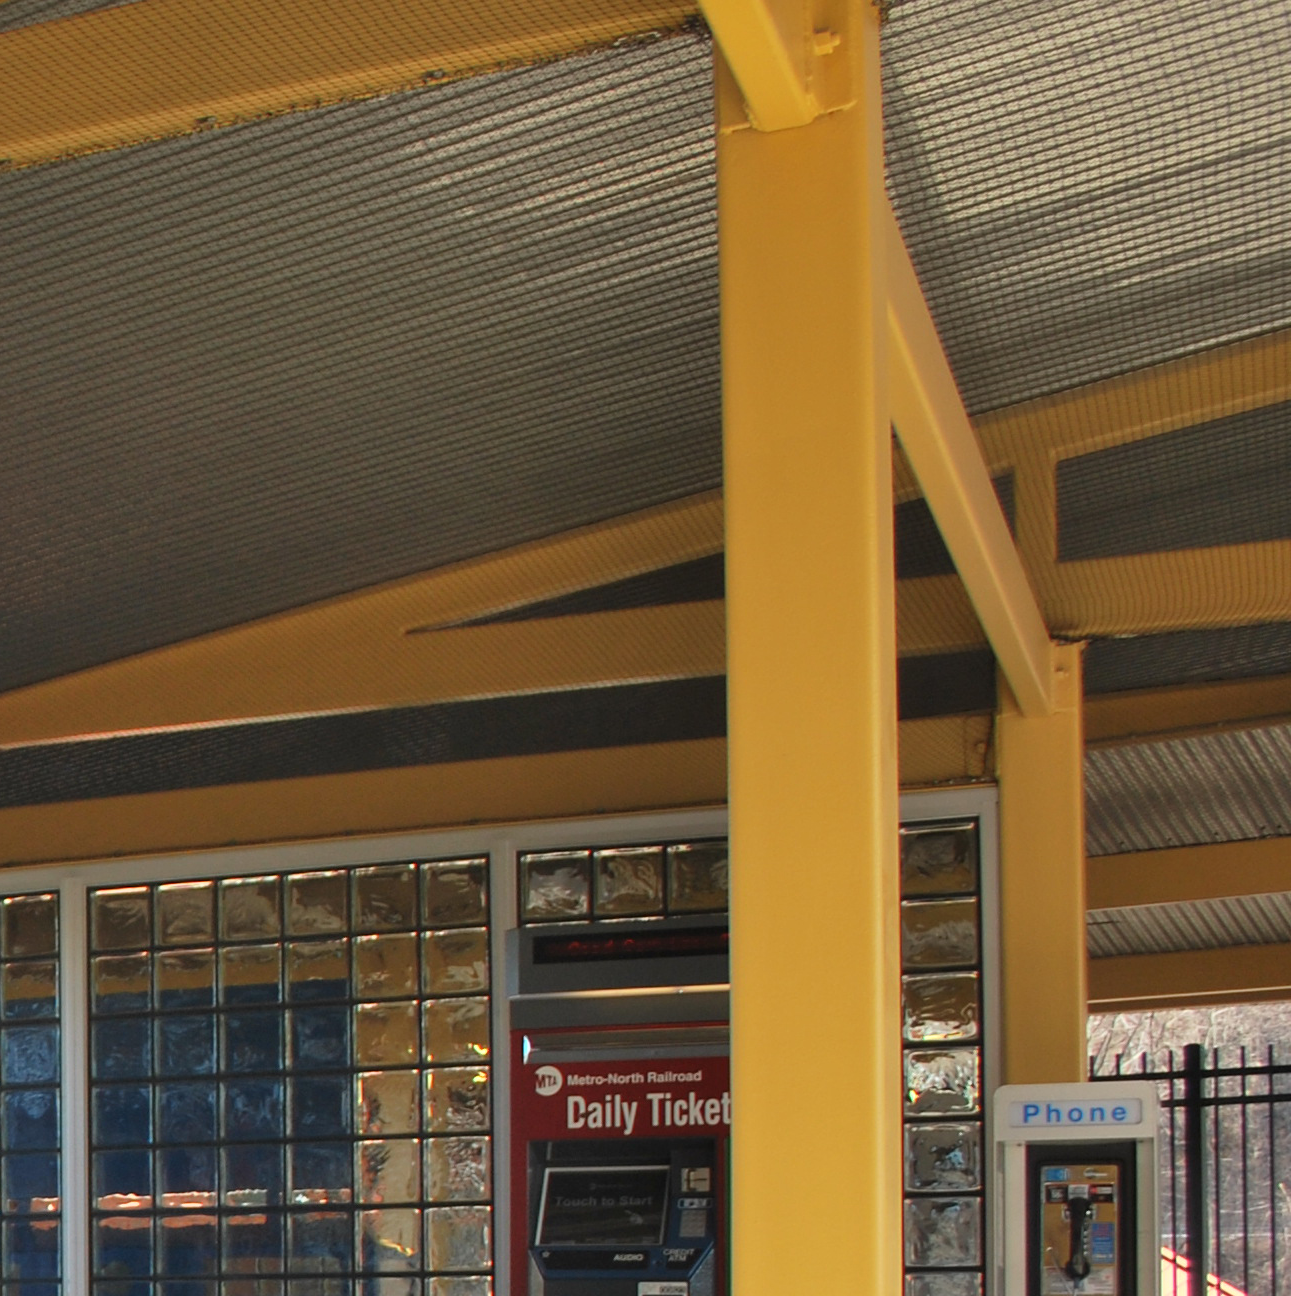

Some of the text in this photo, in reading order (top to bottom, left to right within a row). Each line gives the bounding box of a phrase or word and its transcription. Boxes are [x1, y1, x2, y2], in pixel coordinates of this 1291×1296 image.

[567, 1073, 644, 1086] Metro-North
[647, 1070, 702, 1083] Railroad
[567, 1093, 638, 1136] Daily
[1023, 1103, 1128, 1124] Phone
[554, 1195, 654, 1207] Touch to Start
[613, 1253, 644, 1262] AUDIO
[663, 1248, 695, 1257] CREDIT
[668, 1254, 687, 1262] ATM
